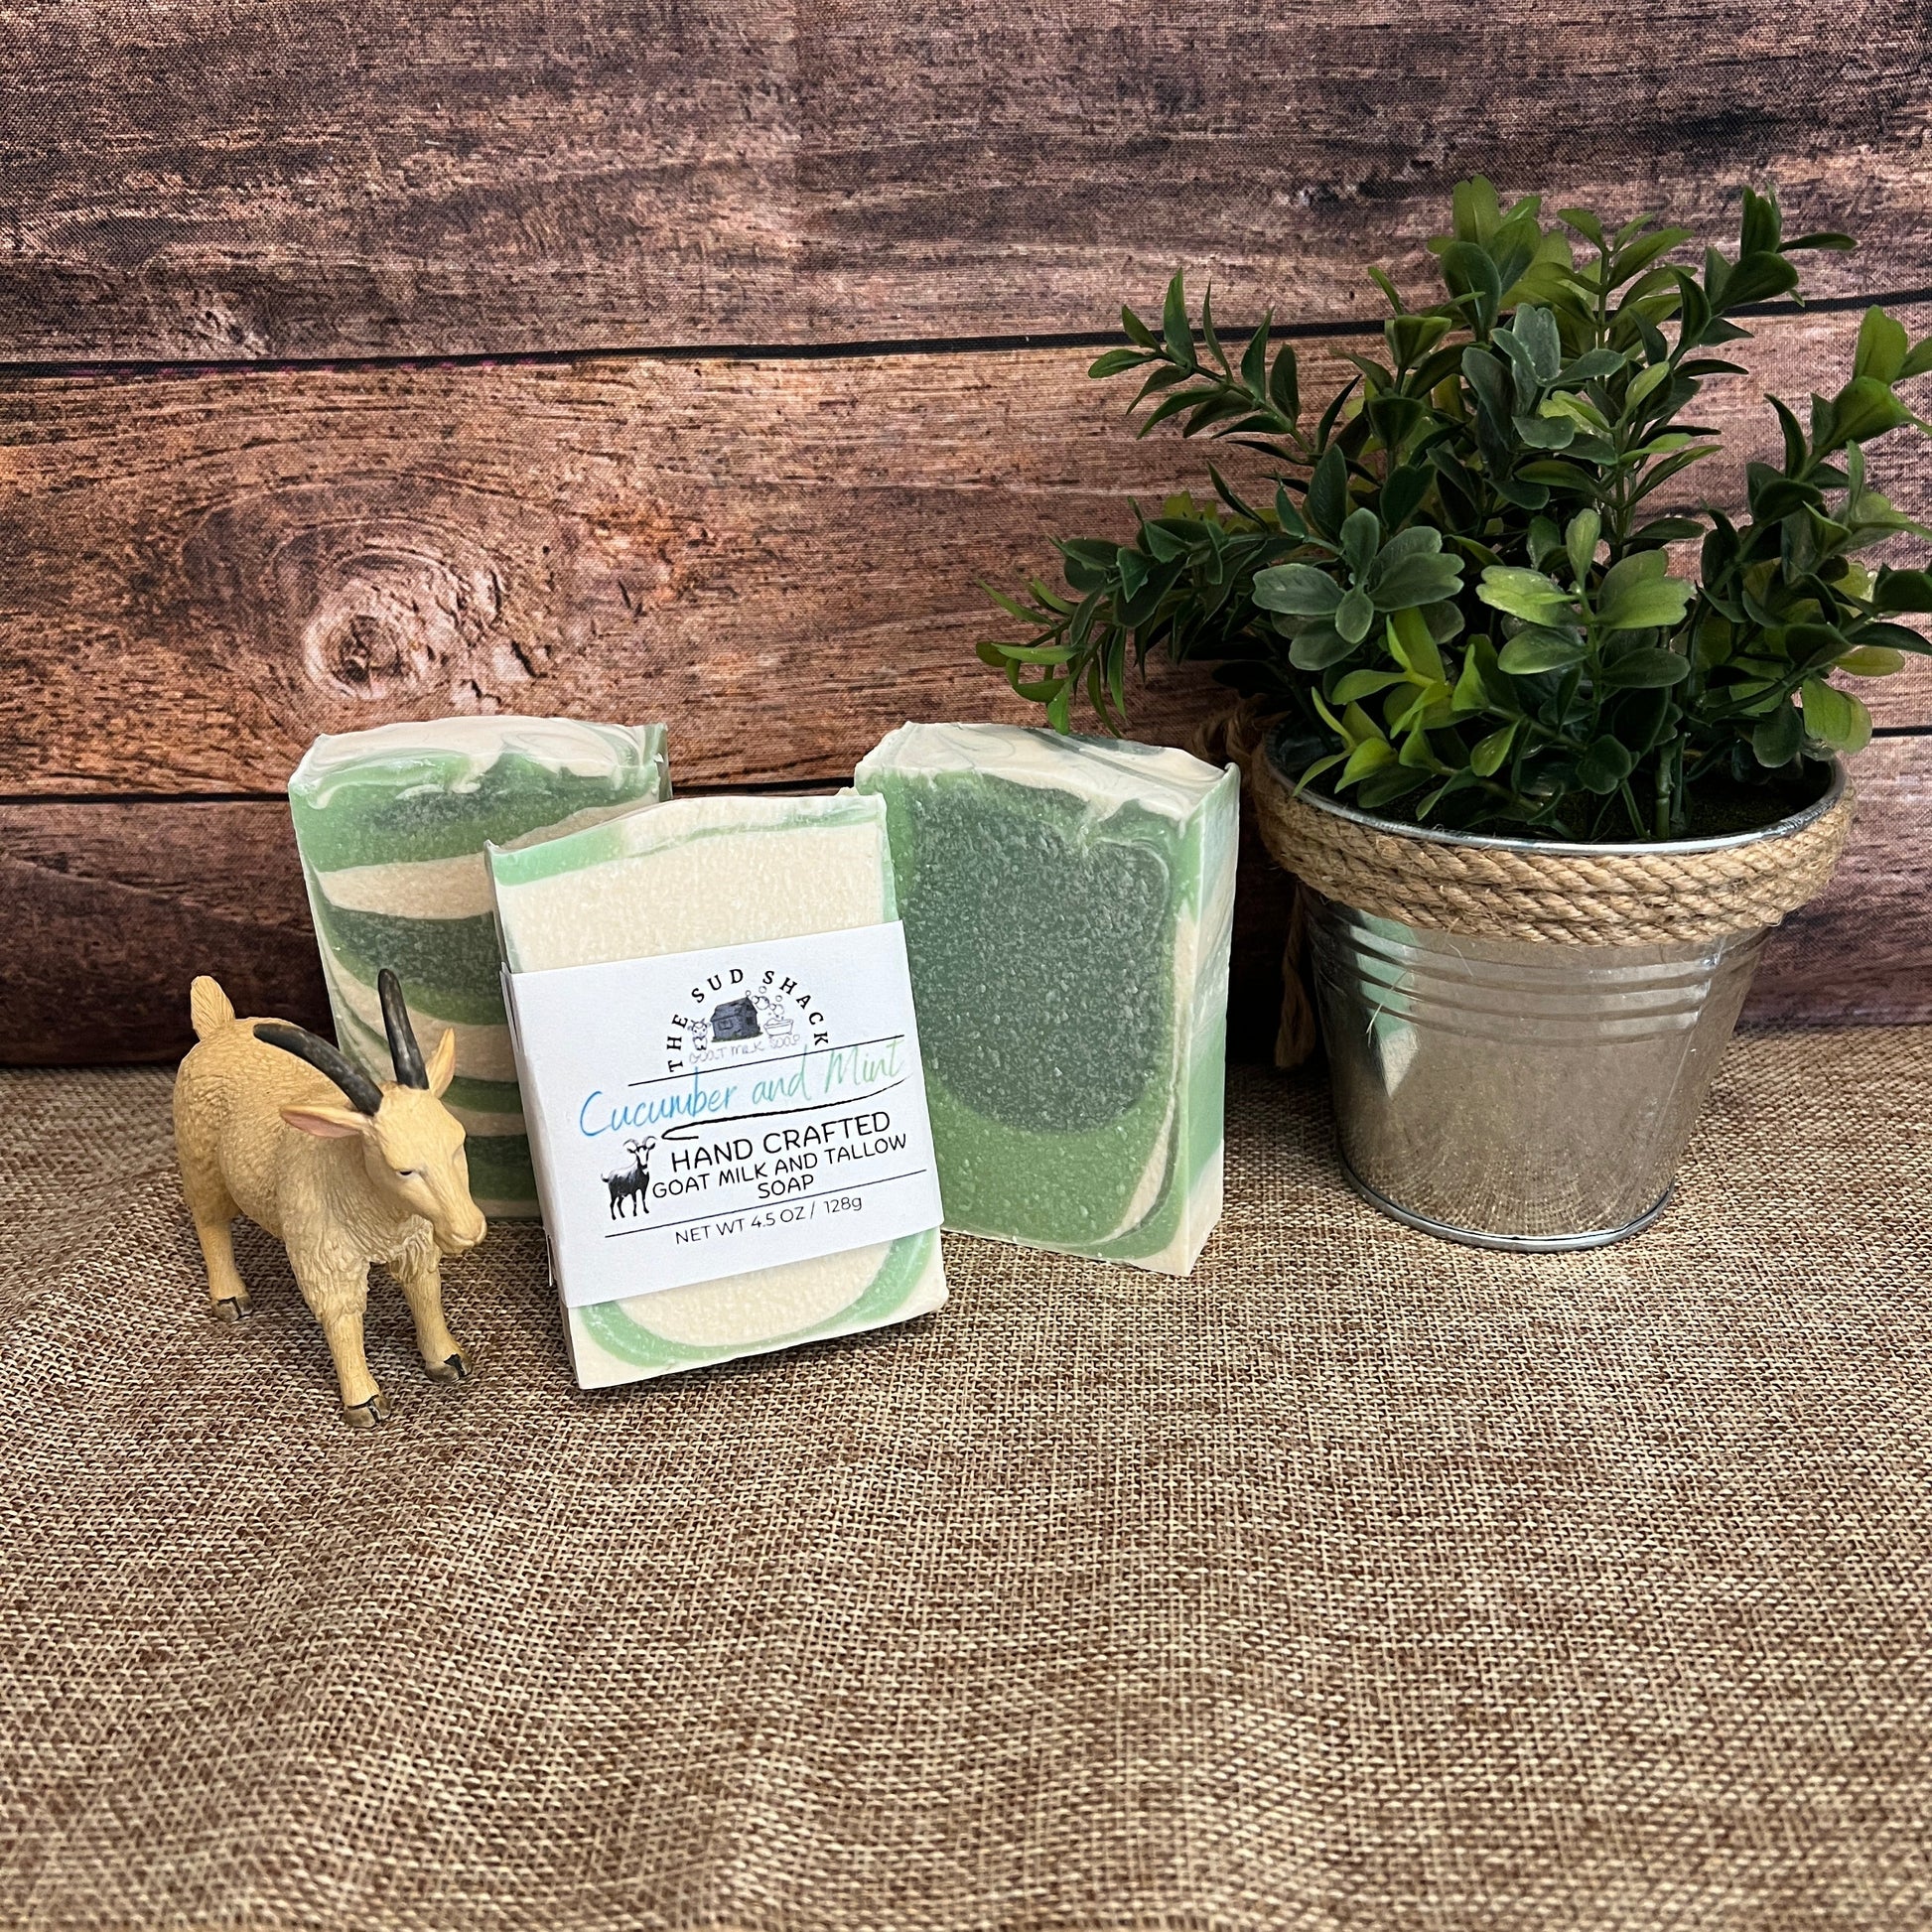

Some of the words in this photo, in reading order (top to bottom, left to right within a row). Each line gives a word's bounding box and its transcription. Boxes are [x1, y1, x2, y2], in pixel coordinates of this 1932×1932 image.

[667, 1014, 688, 1072] THE
[691, 968, 744, 1003] SUD
[762, 970, 828, 1046] SHACK
[580, 1066, 738, 1137] Cucumber
[753, 1044, 812, 1104] and
[825, 1038, 904, 1093] Mint
[652, 1173, 710, 1198] GOAT
[719, 1162, 768, 1186] MILK
[774, 1152, 818, 1175] AND
[824, 1133, 906, 1166] TALLOW
[671, 1140, 754, 1173] HAND
[762, 1111, 891, 1155] CRAFTED
[758, 1173, 814, 1199] SOAP
[675, 1225, 709, 1245] NET
[716, 1218, 745, 1236] WT
[751, 1212, 775, 1230] 4.5
[780, 1205, 806, 1223] OZ
[824, 1196, 863, 1215] 128g
